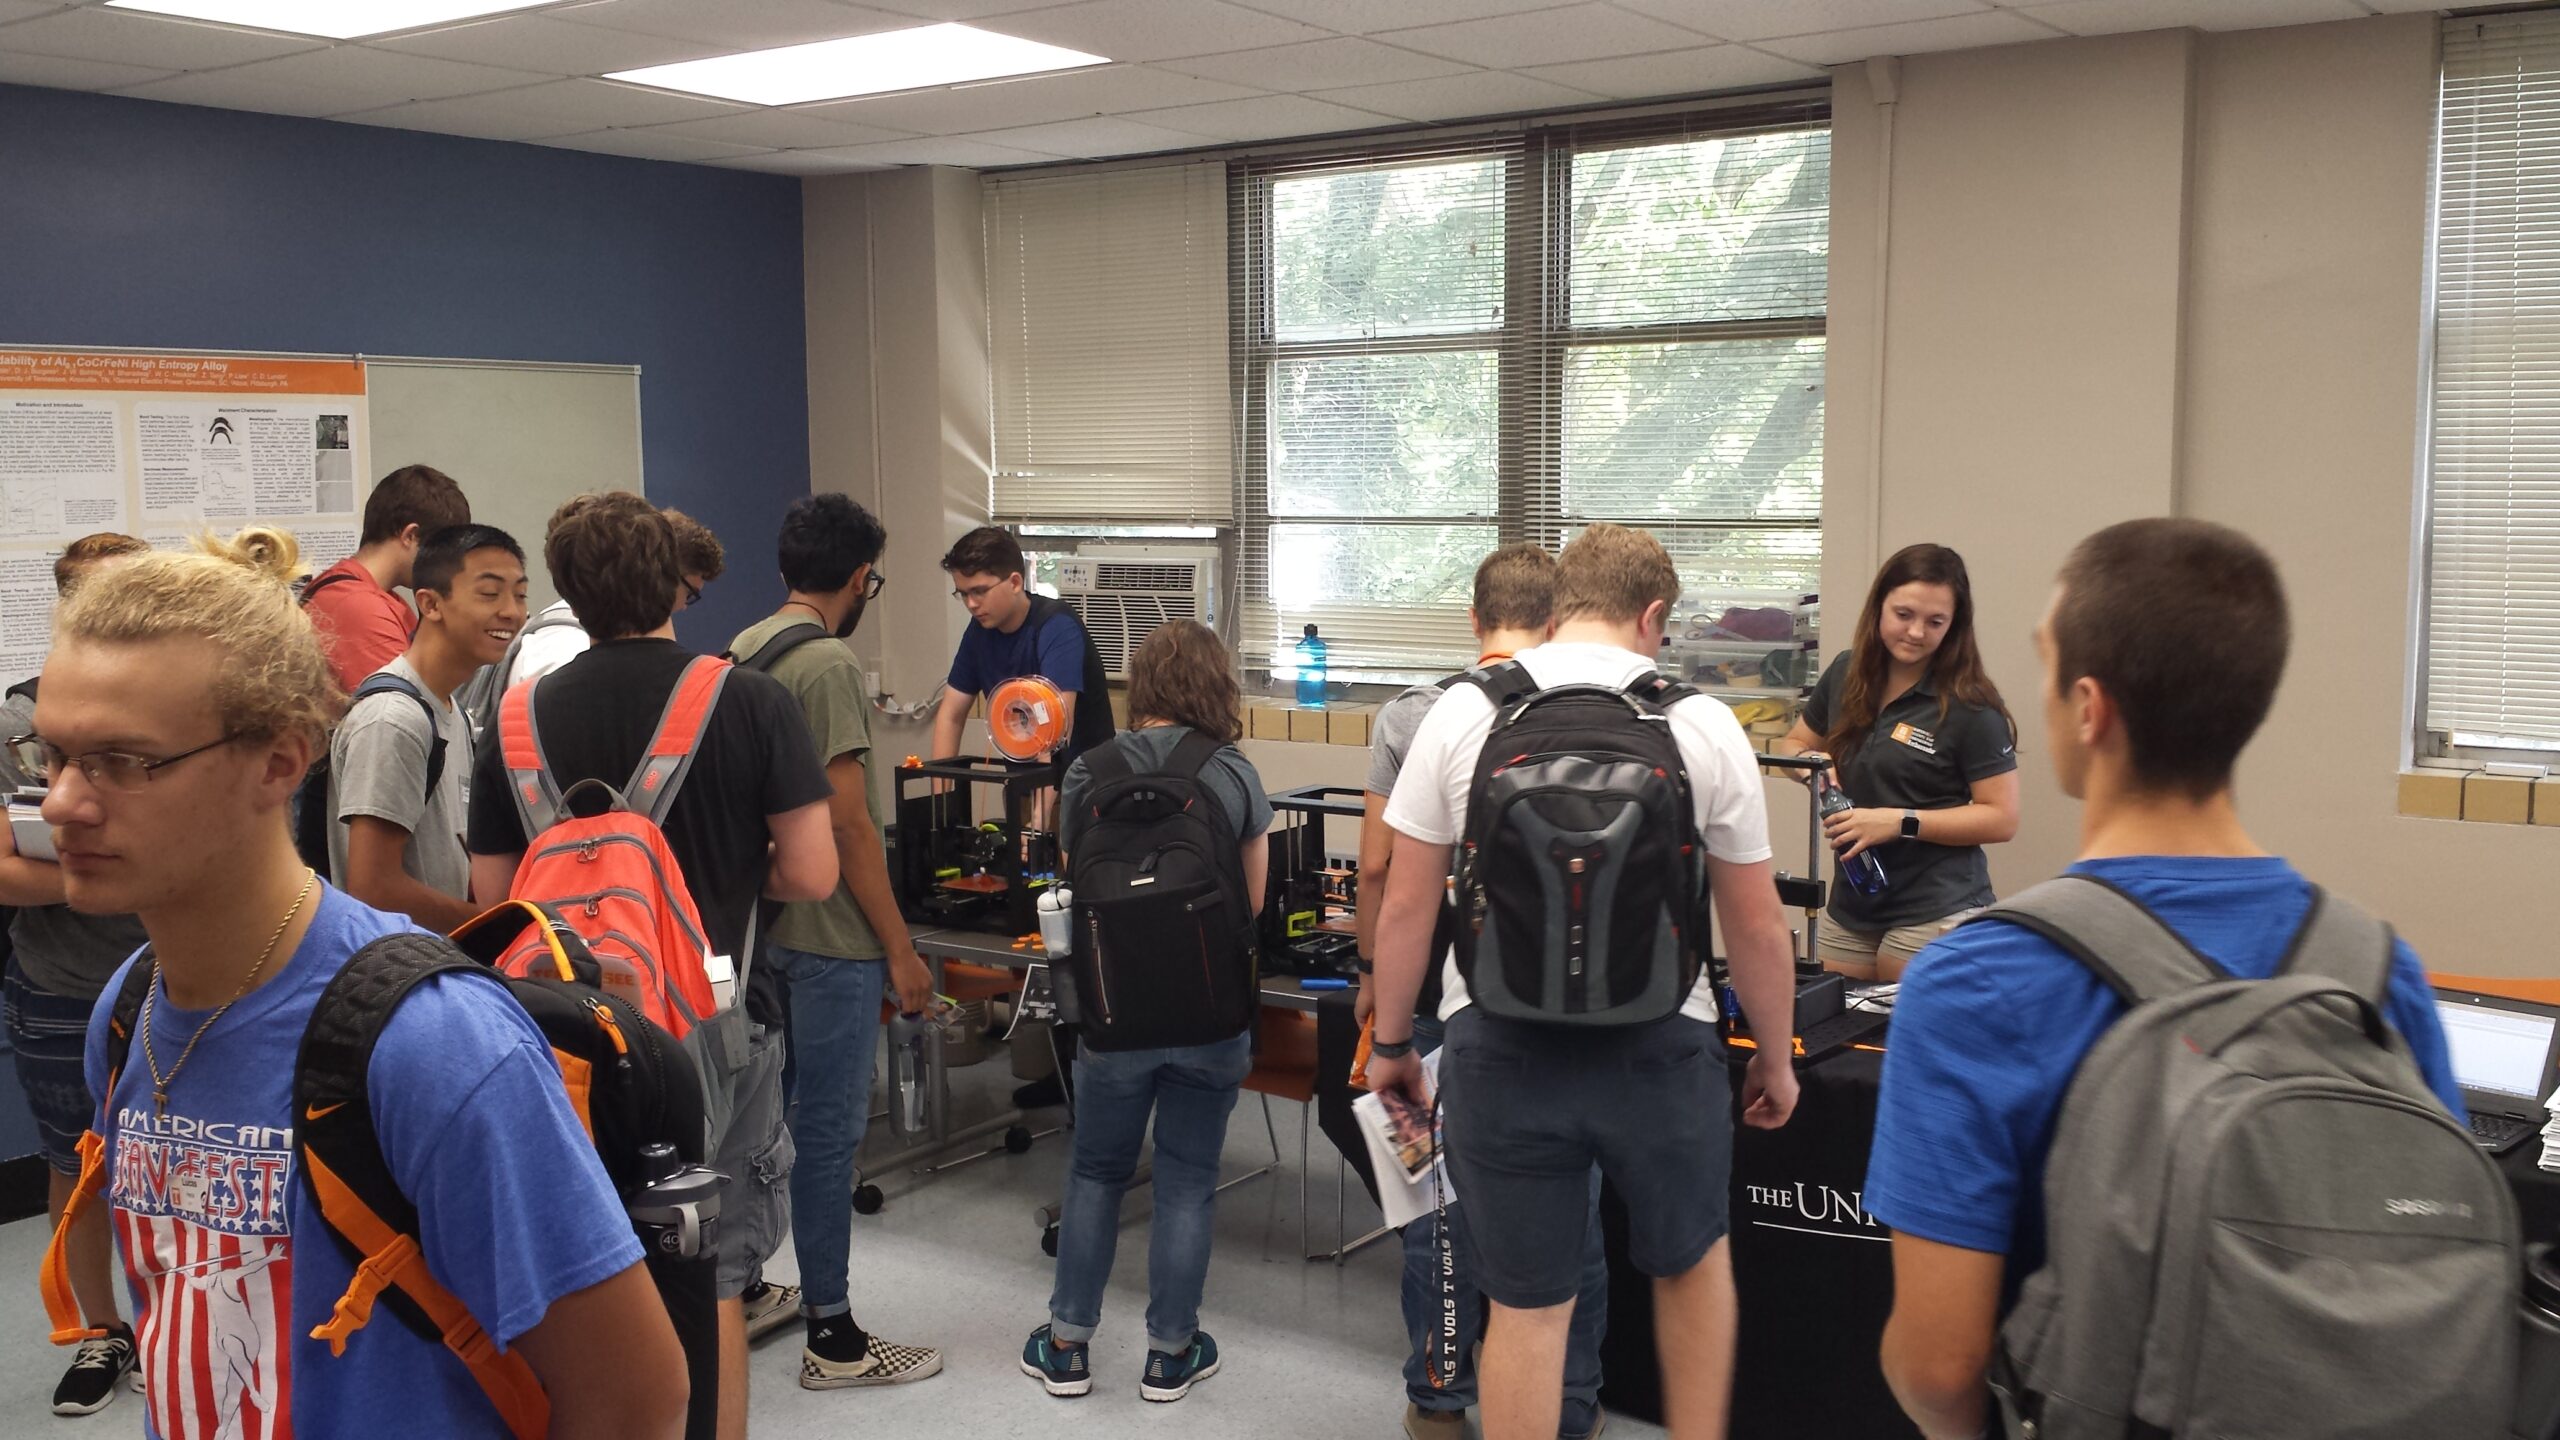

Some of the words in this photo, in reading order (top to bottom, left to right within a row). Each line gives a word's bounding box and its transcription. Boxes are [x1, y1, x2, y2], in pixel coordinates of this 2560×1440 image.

[40, 356, 53, 366] of
[131, 359, 156, 370] High
[158, 359, 200, 372] Entropy
[201, 361, 228, 373] Alloy
[118, 1108, 294, 1149] AMERICAN
[1746, 1185, 1793, 1208] THE
[1441, 1237, 1454, 1276] VOLS
[1443, 1298, 1457, 1337] VOLS
